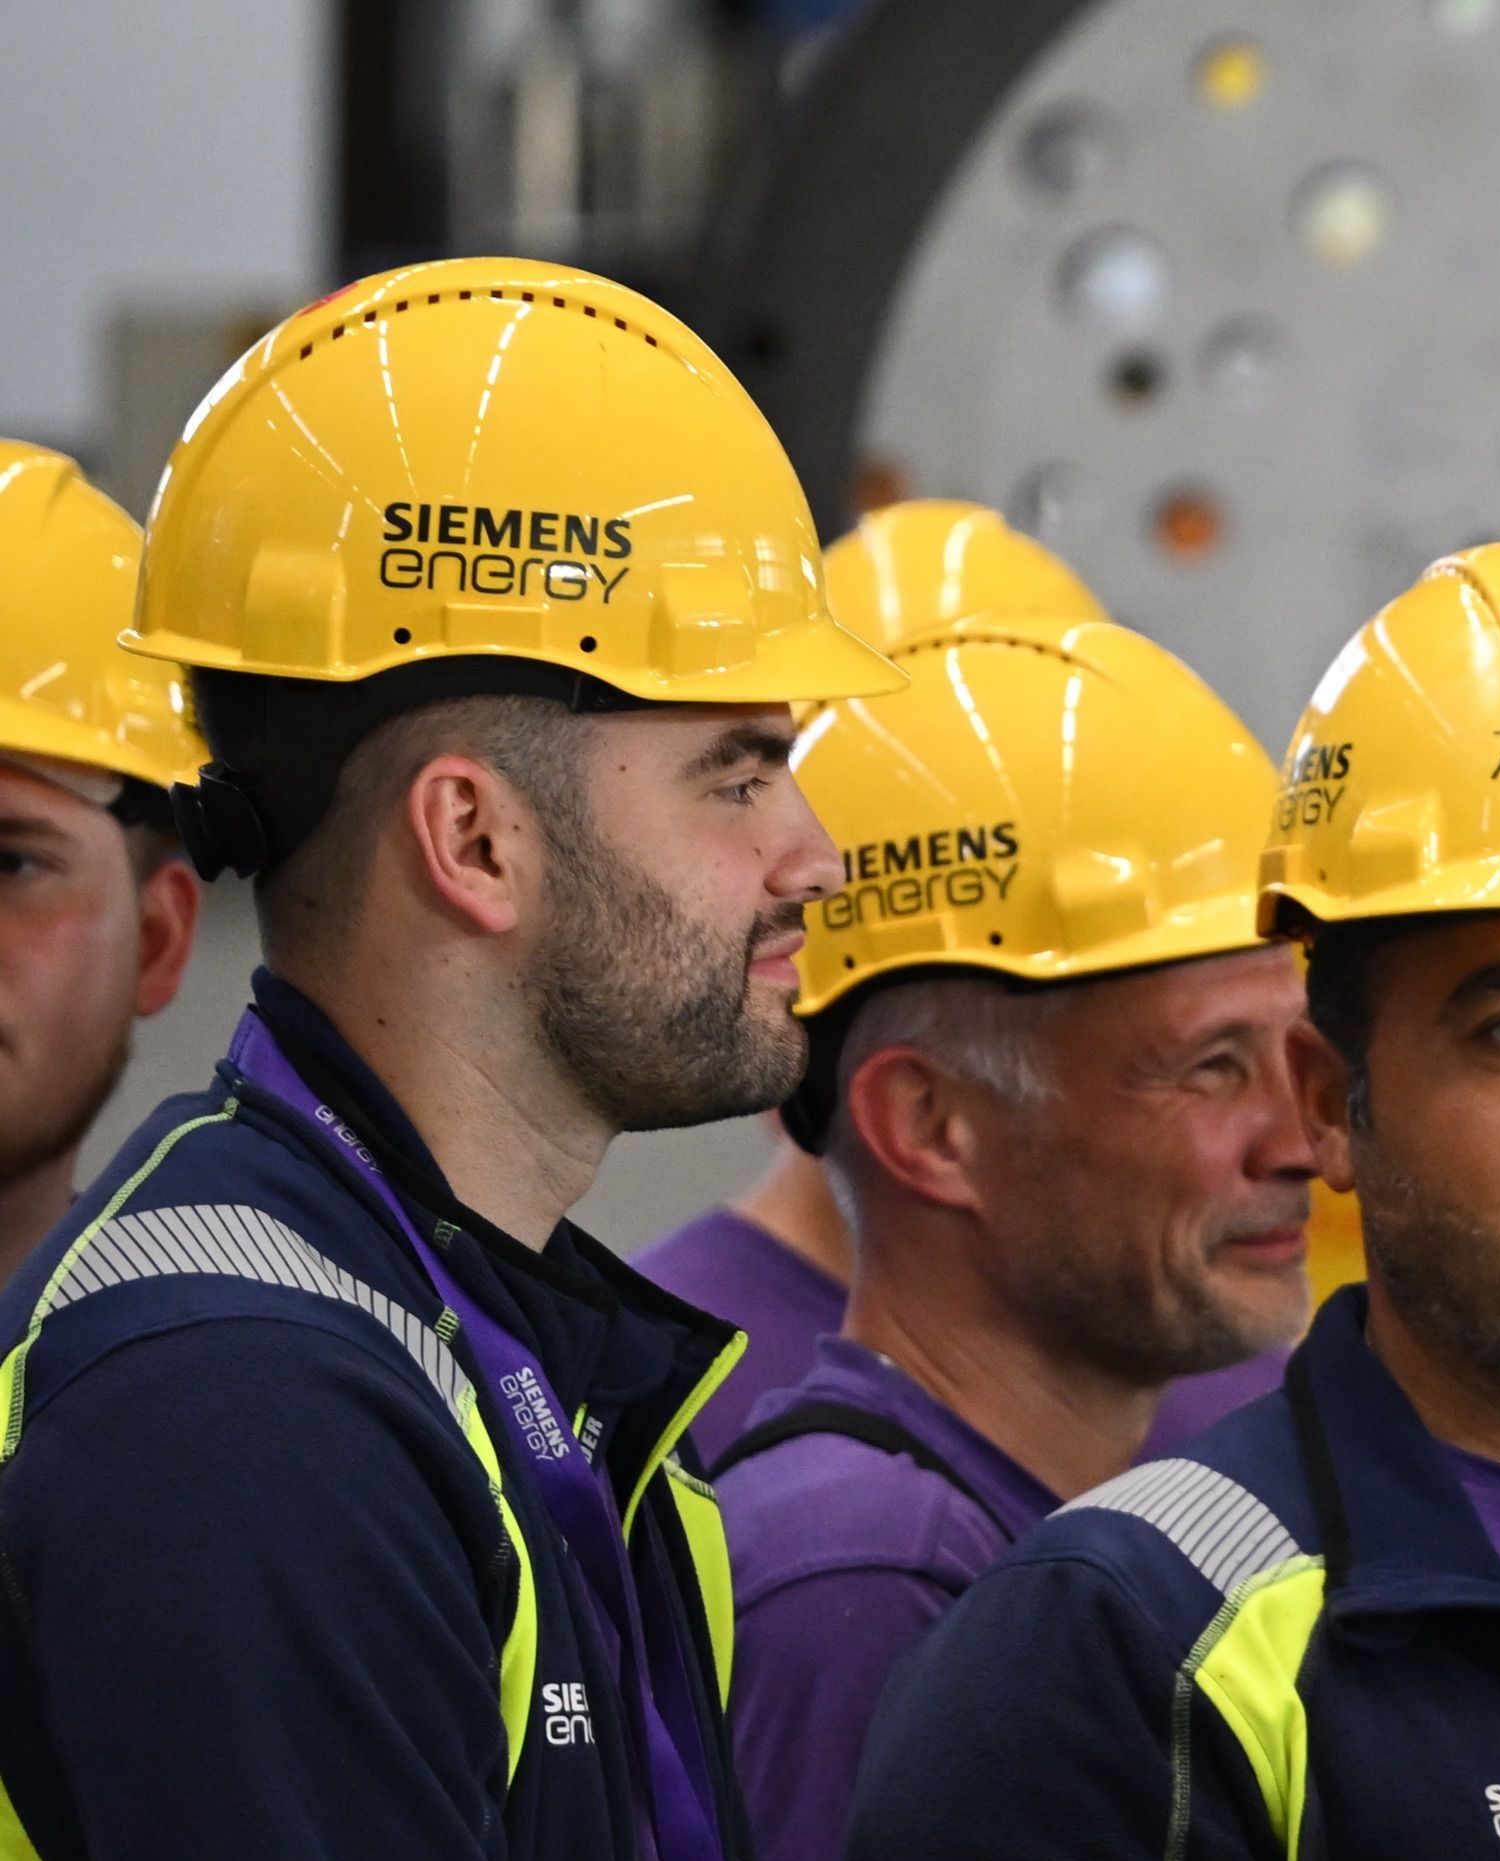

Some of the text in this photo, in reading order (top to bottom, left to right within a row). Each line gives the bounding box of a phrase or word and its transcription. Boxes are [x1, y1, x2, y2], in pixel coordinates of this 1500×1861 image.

[383, 502, 633, 559] SIEMENS
[379, 548, 630, 604] energy
[842, 822, 1019, 883] IEMENS
[822, 863, 1019, 930] energy
[500, 1374, 555, 1461] energy
[515, 1366, 570, 1458] SIEMENS
